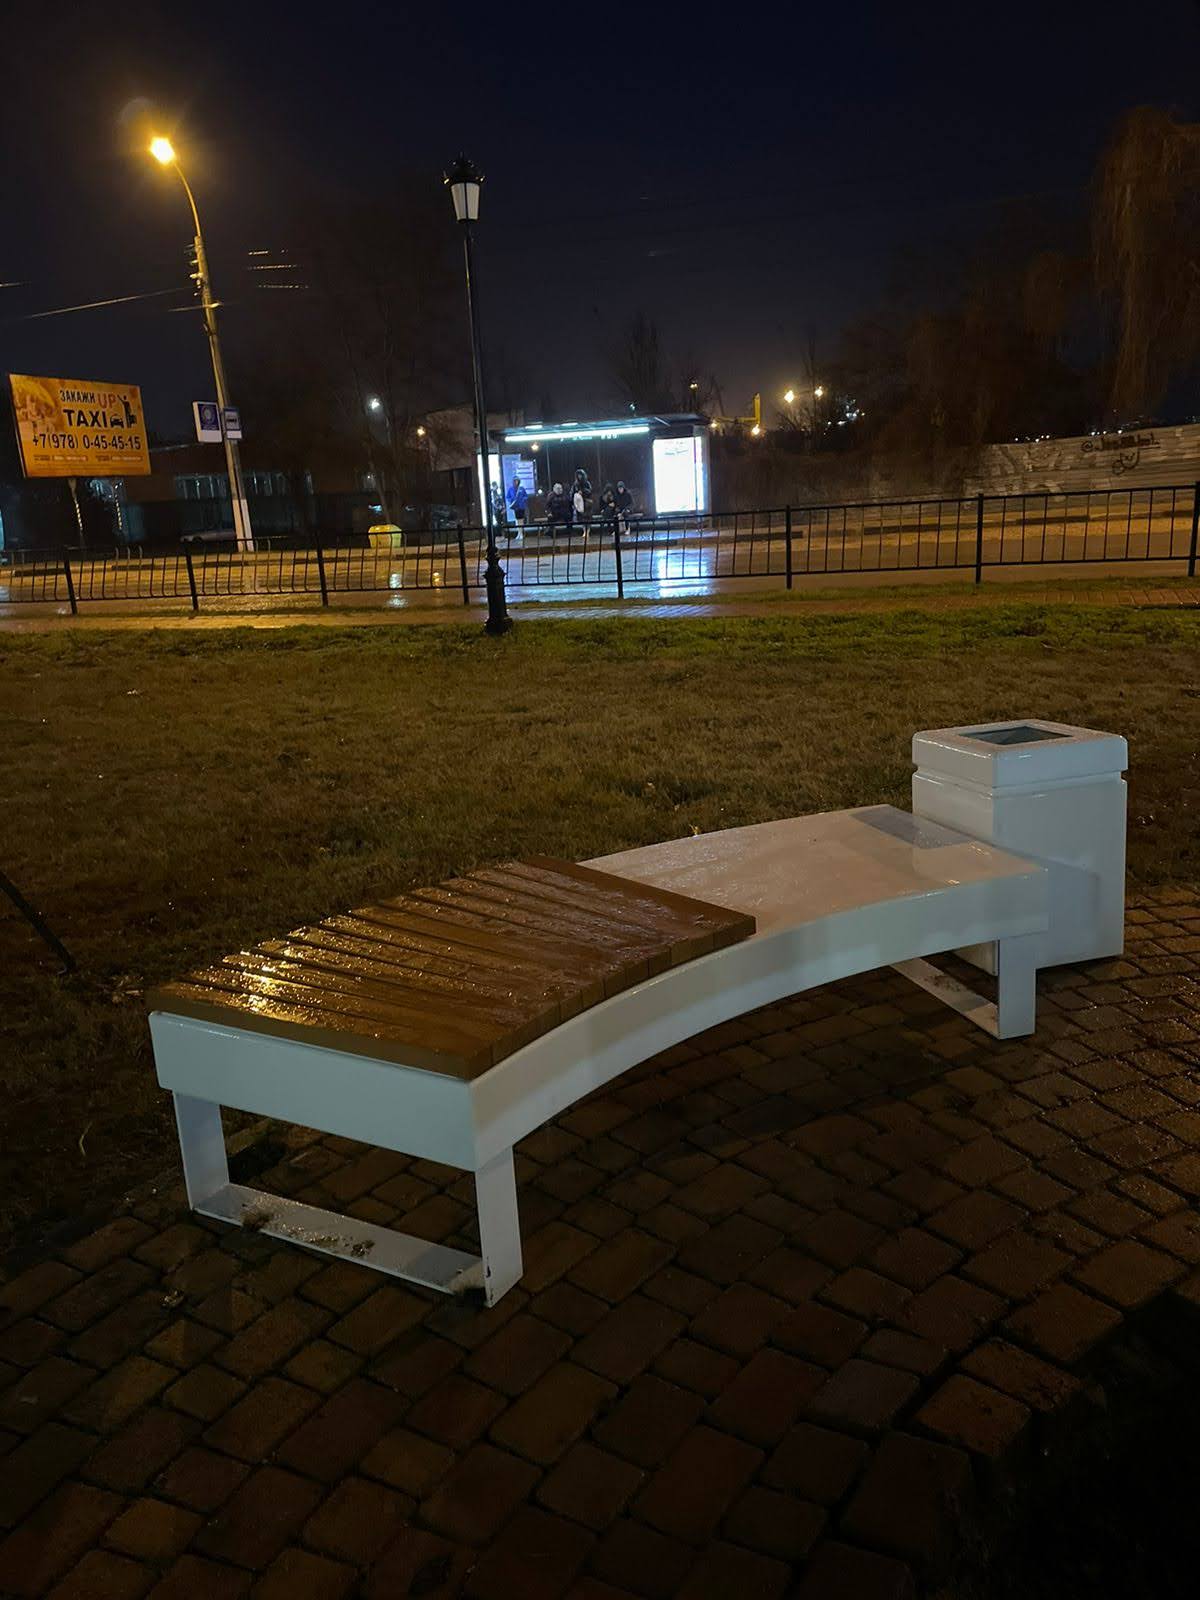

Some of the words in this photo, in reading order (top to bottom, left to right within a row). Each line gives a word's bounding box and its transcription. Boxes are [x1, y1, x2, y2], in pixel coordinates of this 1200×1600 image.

[60, 390, 96, 403] ЗАКАЖИ
[98, 394, 117, 409] UP
[63, 409, 108, 428] TAXI
[33, 433, 79, 449] +7(978)
[83, 434, 141, 450] 0-45-45-15
